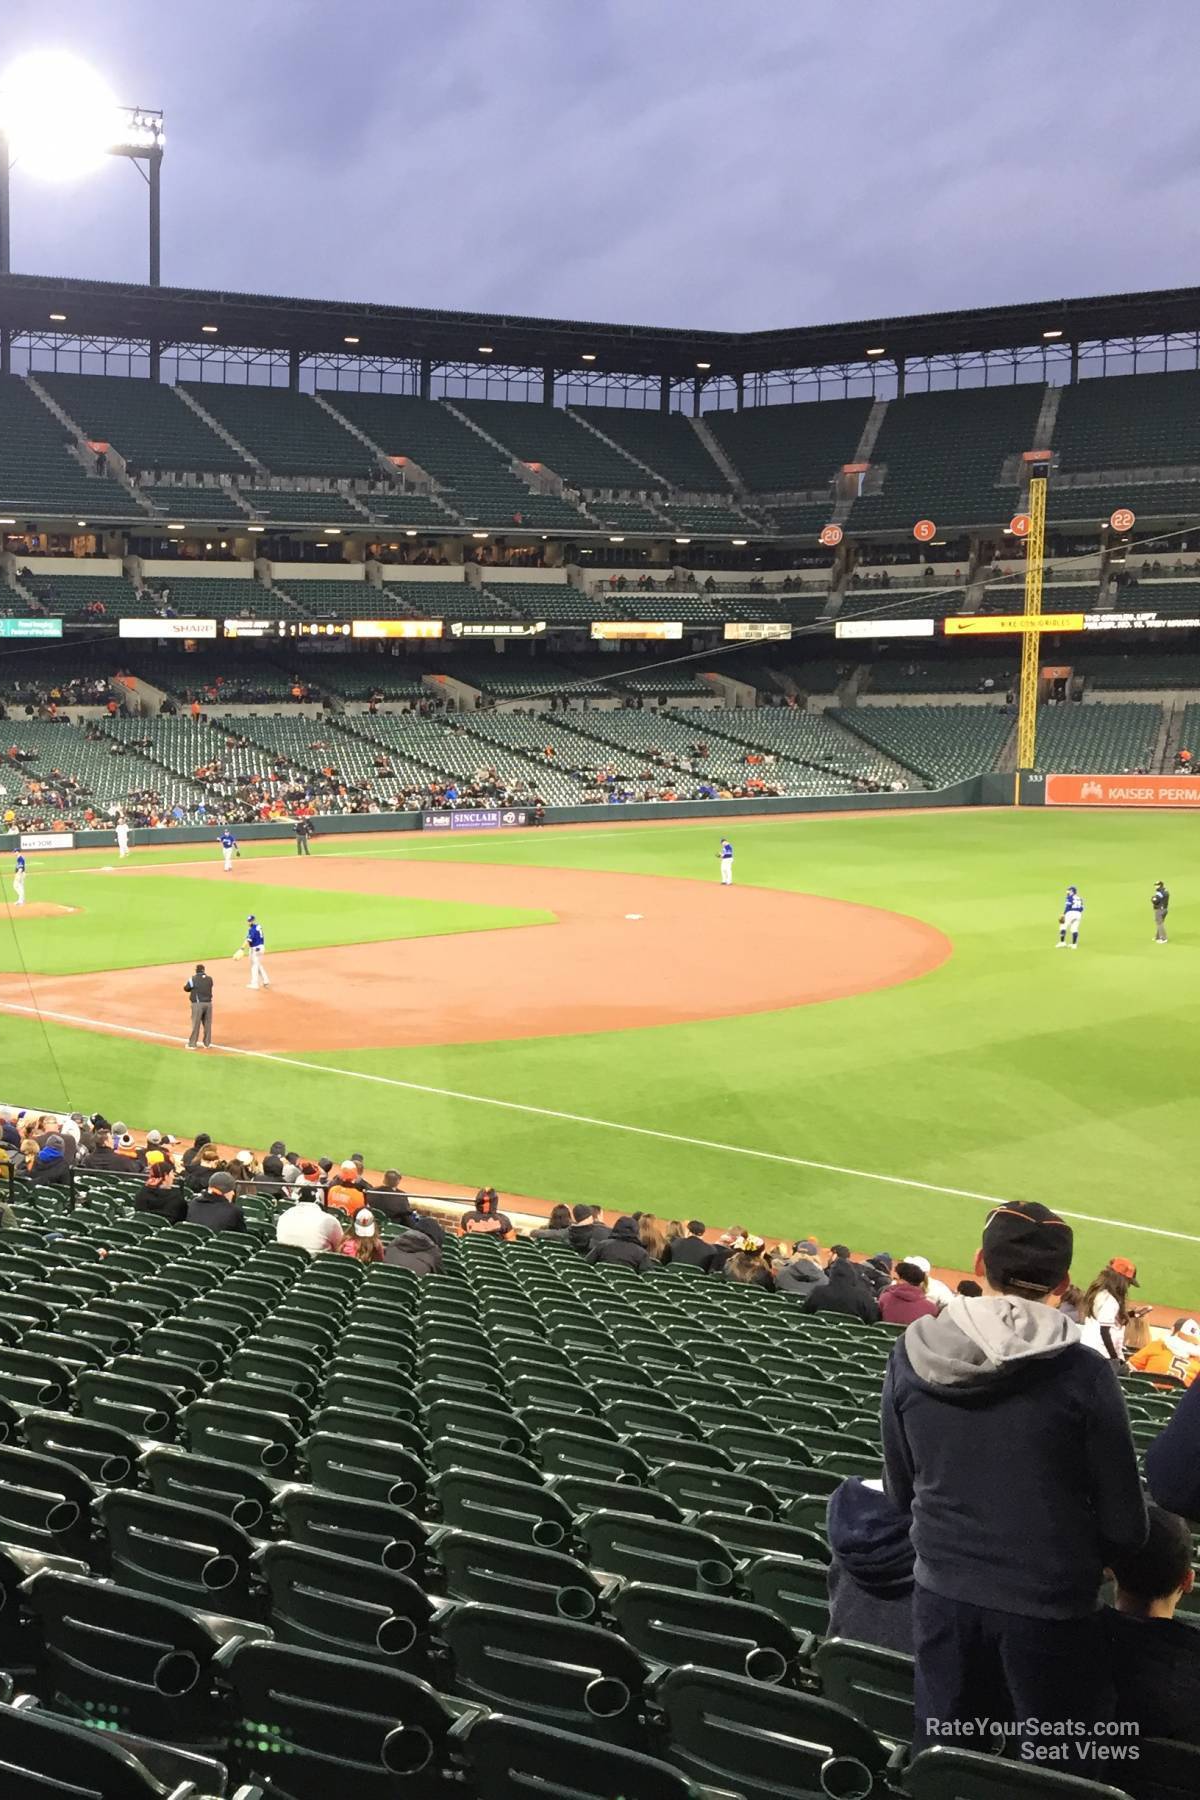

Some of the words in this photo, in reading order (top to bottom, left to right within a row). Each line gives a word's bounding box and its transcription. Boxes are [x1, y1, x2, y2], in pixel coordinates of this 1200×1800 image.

[1016, 519, 1025, 531] 4
[1113, 514, 1131, 525] 22
[824, 530, 839, 541] 20
[920, 525, 929, 537] 5
[173, 624, 213, 632] SHARP
[1027, 774, 1043, 782] 333
[1108, 788, 1154, 800] KAISER
[454, 813, 498, 822] SINCLAIR
[1170, 1356, 1190, 1380] 5
